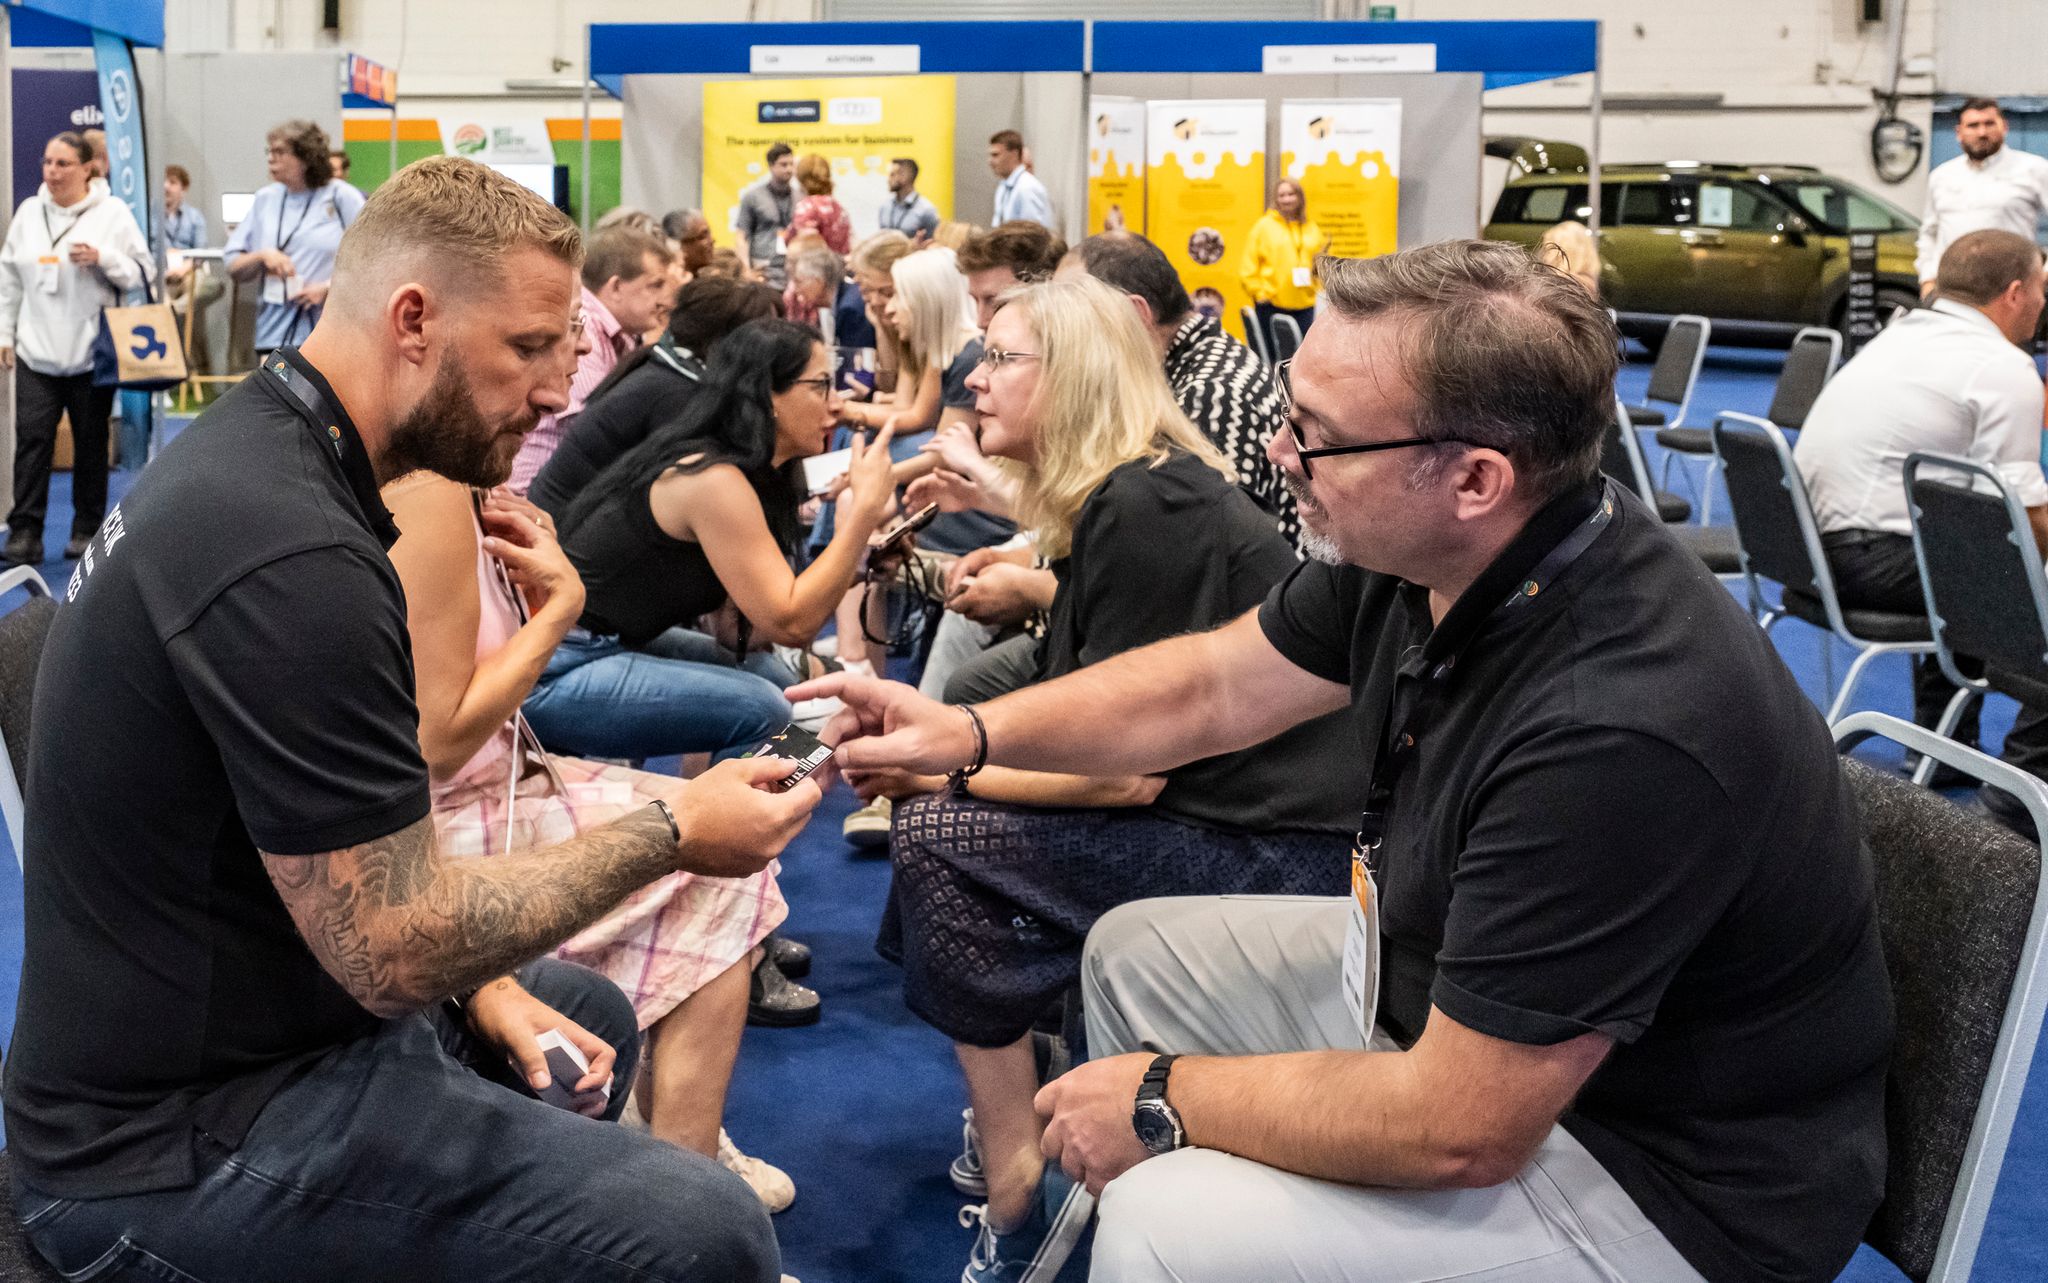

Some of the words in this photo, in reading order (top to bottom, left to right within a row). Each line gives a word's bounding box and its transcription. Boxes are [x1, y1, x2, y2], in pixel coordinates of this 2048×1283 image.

[726, 136, 744, 145] The
[749, 137, 800, 148] operating
[804, 137, 841, 146] system
[845, 135, 859, 145] for
[863, 136, 914, 145] business
